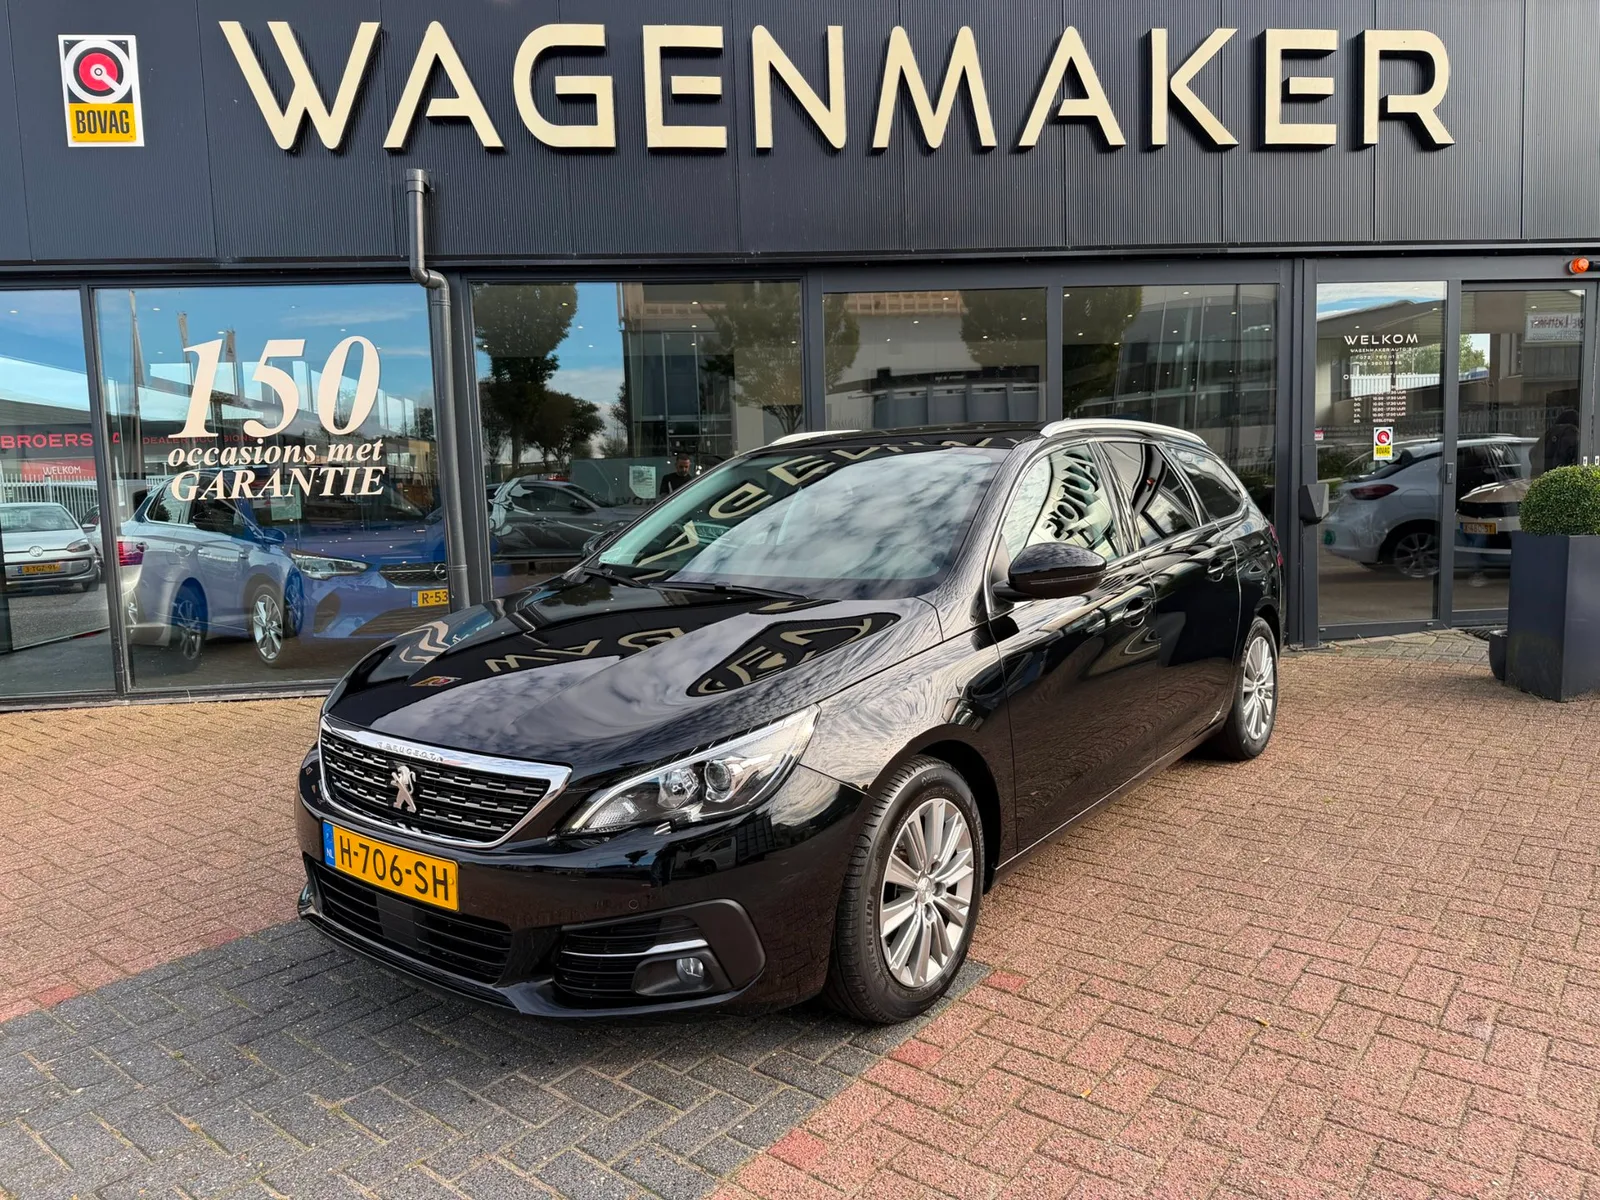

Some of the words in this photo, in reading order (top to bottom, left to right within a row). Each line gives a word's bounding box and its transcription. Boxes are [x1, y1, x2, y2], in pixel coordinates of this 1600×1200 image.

[219, 21, 1455, 150] WAGENMAKER
[75, 109, 131, 136] BOVAG
[1344, 333, 1418, 345] WELKOM
[168, 336, 381, 439] 150
[167, 438, 317, 467] occasions
[327, 439, 383, 462] met
[42, 465, 81, 475] WELKOM
[171, 467, 386, 502] GARANTIE
[339, 835, 449, 901] H-706-SH
